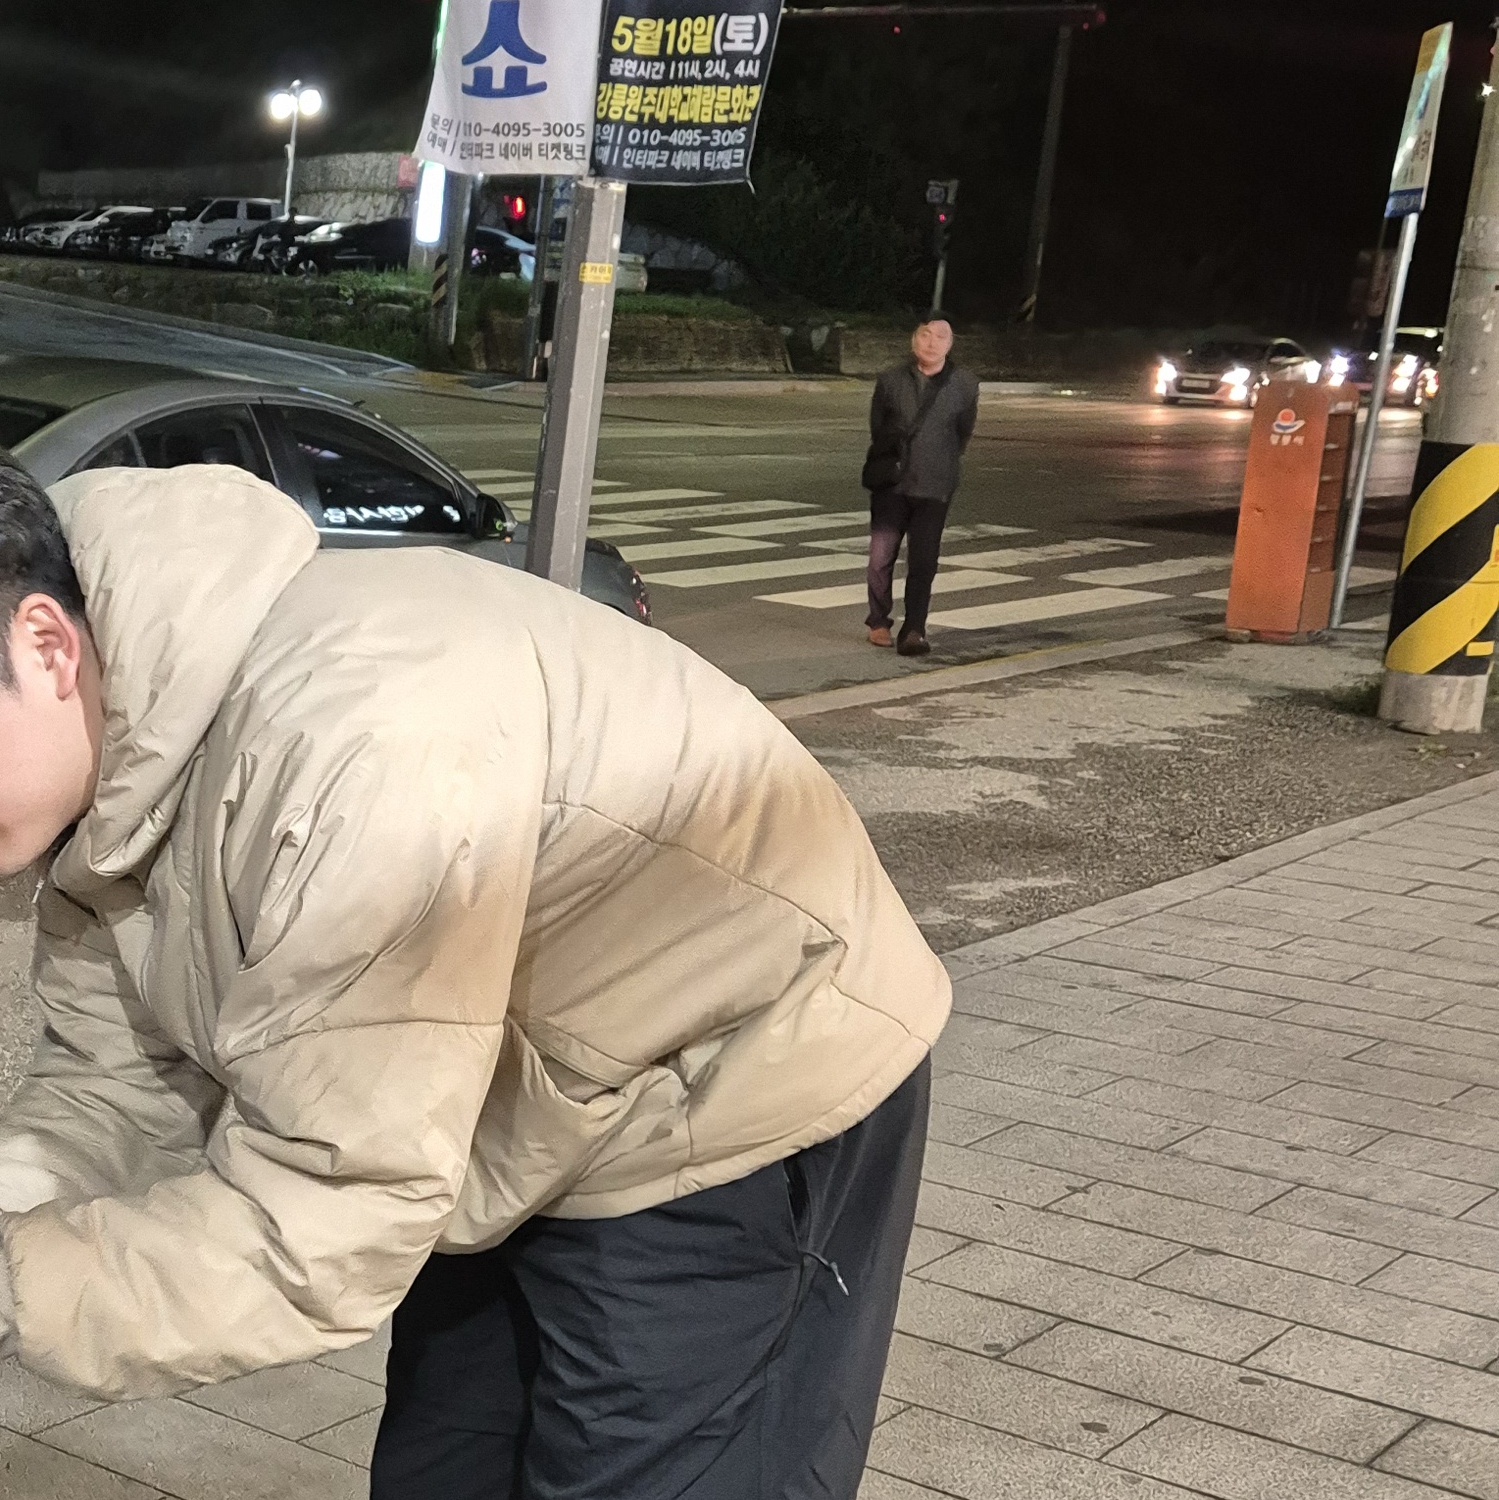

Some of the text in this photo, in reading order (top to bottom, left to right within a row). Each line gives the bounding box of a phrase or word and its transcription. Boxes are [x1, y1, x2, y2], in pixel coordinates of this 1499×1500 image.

[609, 58, 666, 80] 공연시간
[734, 59, 761, 79] 4시
[430, 112, 454, 136] 문의
[499, 141, 533, 161] 네이버
[538, 142, 586, 161] 티켓링크
[622, 146, 669, 169] 인터파크
